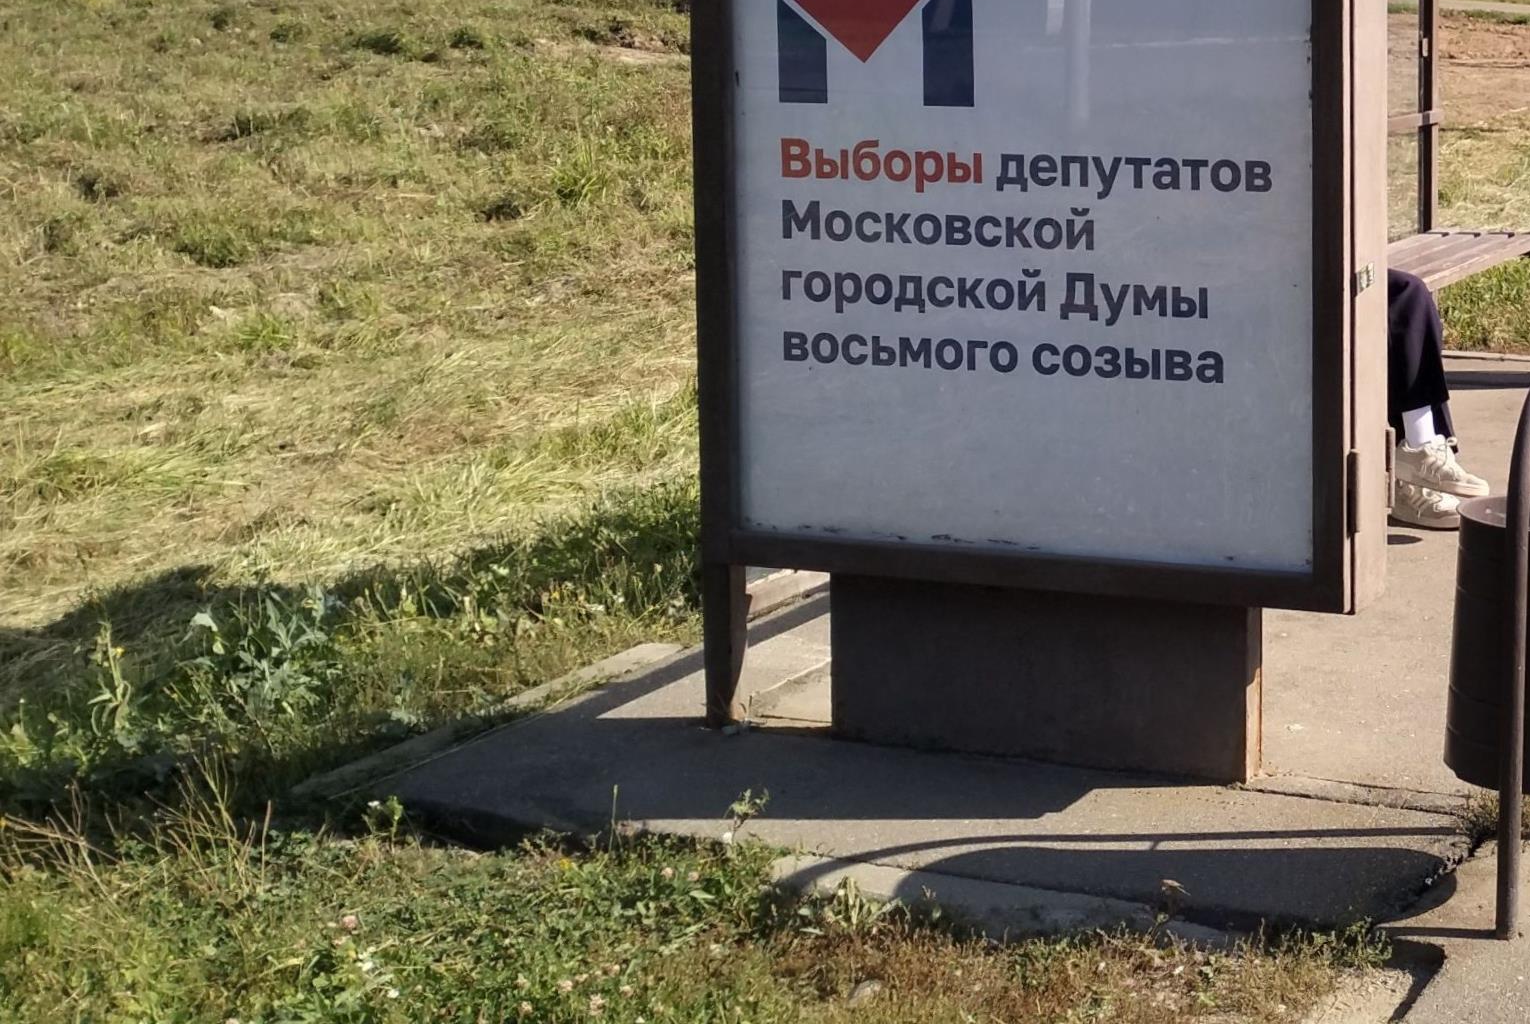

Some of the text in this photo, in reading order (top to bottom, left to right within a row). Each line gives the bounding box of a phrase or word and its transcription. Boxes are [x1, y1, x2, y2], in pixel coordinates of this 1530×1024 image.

[780, 137, 1273, 200] Выборы депутатов
[781, 199, 1095, 251] Московской
[781, 268, 1209, 326] городской Думы
[783, 330, 1226, 385] восьмого созыва
